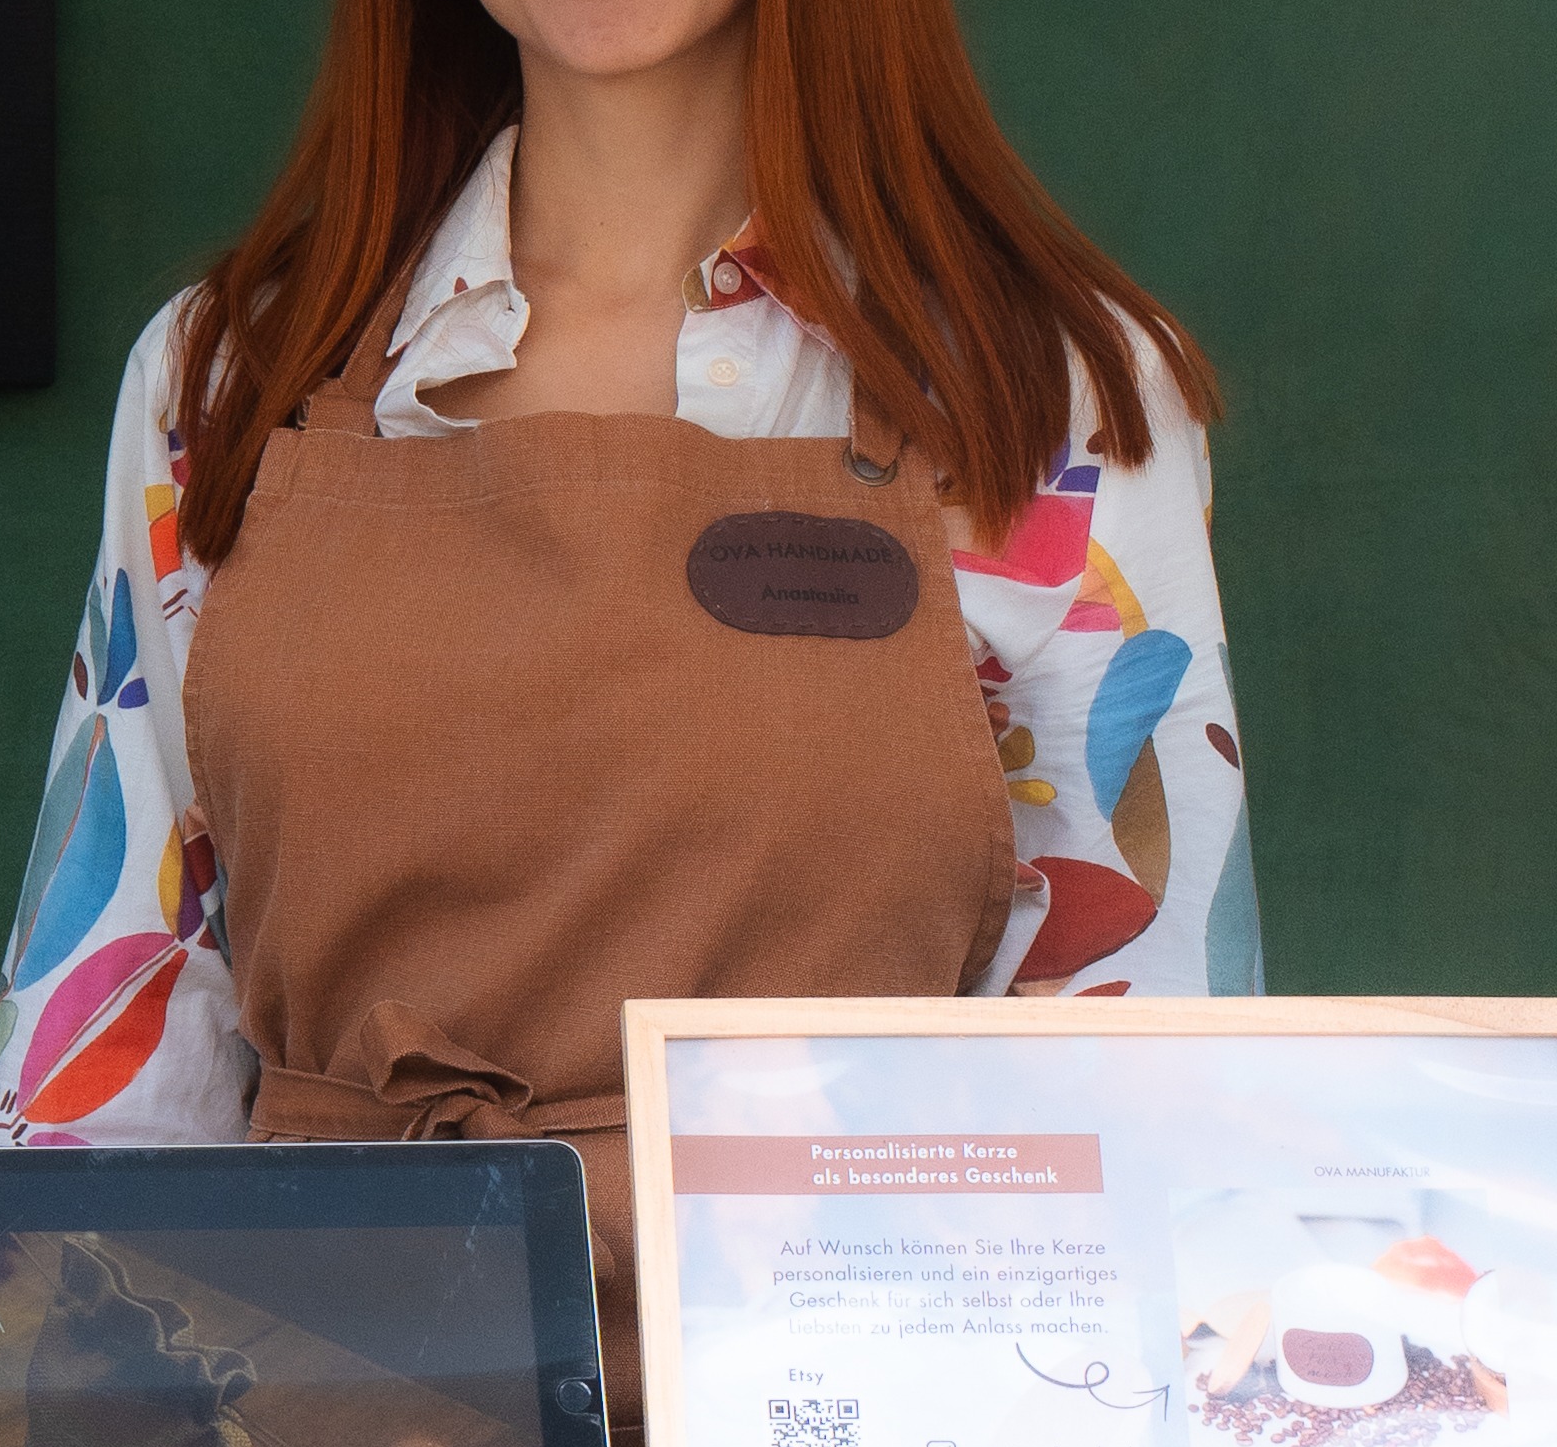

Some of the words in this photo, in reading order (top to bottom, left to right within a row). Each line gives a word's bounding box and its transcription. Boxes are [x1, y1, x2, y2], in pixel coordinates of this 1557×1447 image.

[710, 543, 761, 563] OVA
[767, 541, 894, 564] HANDMADE
[811, 1142, 955, 1160] Personalisierte
[963, 1142, 1018, 1159] Kerze
[813, 1168, 841, 1185] als
[849, 1167, 959, 1185] besonderes
[965, 1166, 1058, 1184] Geschenk
[1314, 1166, 1343, 1177] OVA
[1346, 1166, 1431, 1178] MANUFAKTUR
[780, 1239, 812, 1255] Auf
[818, 1238, 893, 1255] Wunsch
[901, 1237, 967, 1255] können
[975, 1238, 1003, 1255] Sie
[1011, 1239, 1045, 1255] Ihre
[1052, 1239, 1106, 1255] Kerze
[773, 1264, 913, 1286] personalisieren
[921, 1264, 954, 1282] und
[962, 1265, 989, 1282] ein
[997, 1264, 1118, 1285] einzigartiges
[789, 1290, 879, 1309] Geschenk
[887, 1290, 911, 1309] für
[919, 1290, 954, 1308] sich
[962, 1290, 1013, 1308] selbst
[1020, 1290, 1062, 1308] oder
[1070, 1290, 1105, 1308] Ihre
[789, 1318, 862, 1336] Liebsten
[870, 1322, 891, 1335] zu
[898, 1318, 954, 1339] jedem
[963, 1317, 1023, 1335] Anlass
[1030, 1317, 1109, 1334] machen.
[788, 1368, 825, 1386] Etsy
